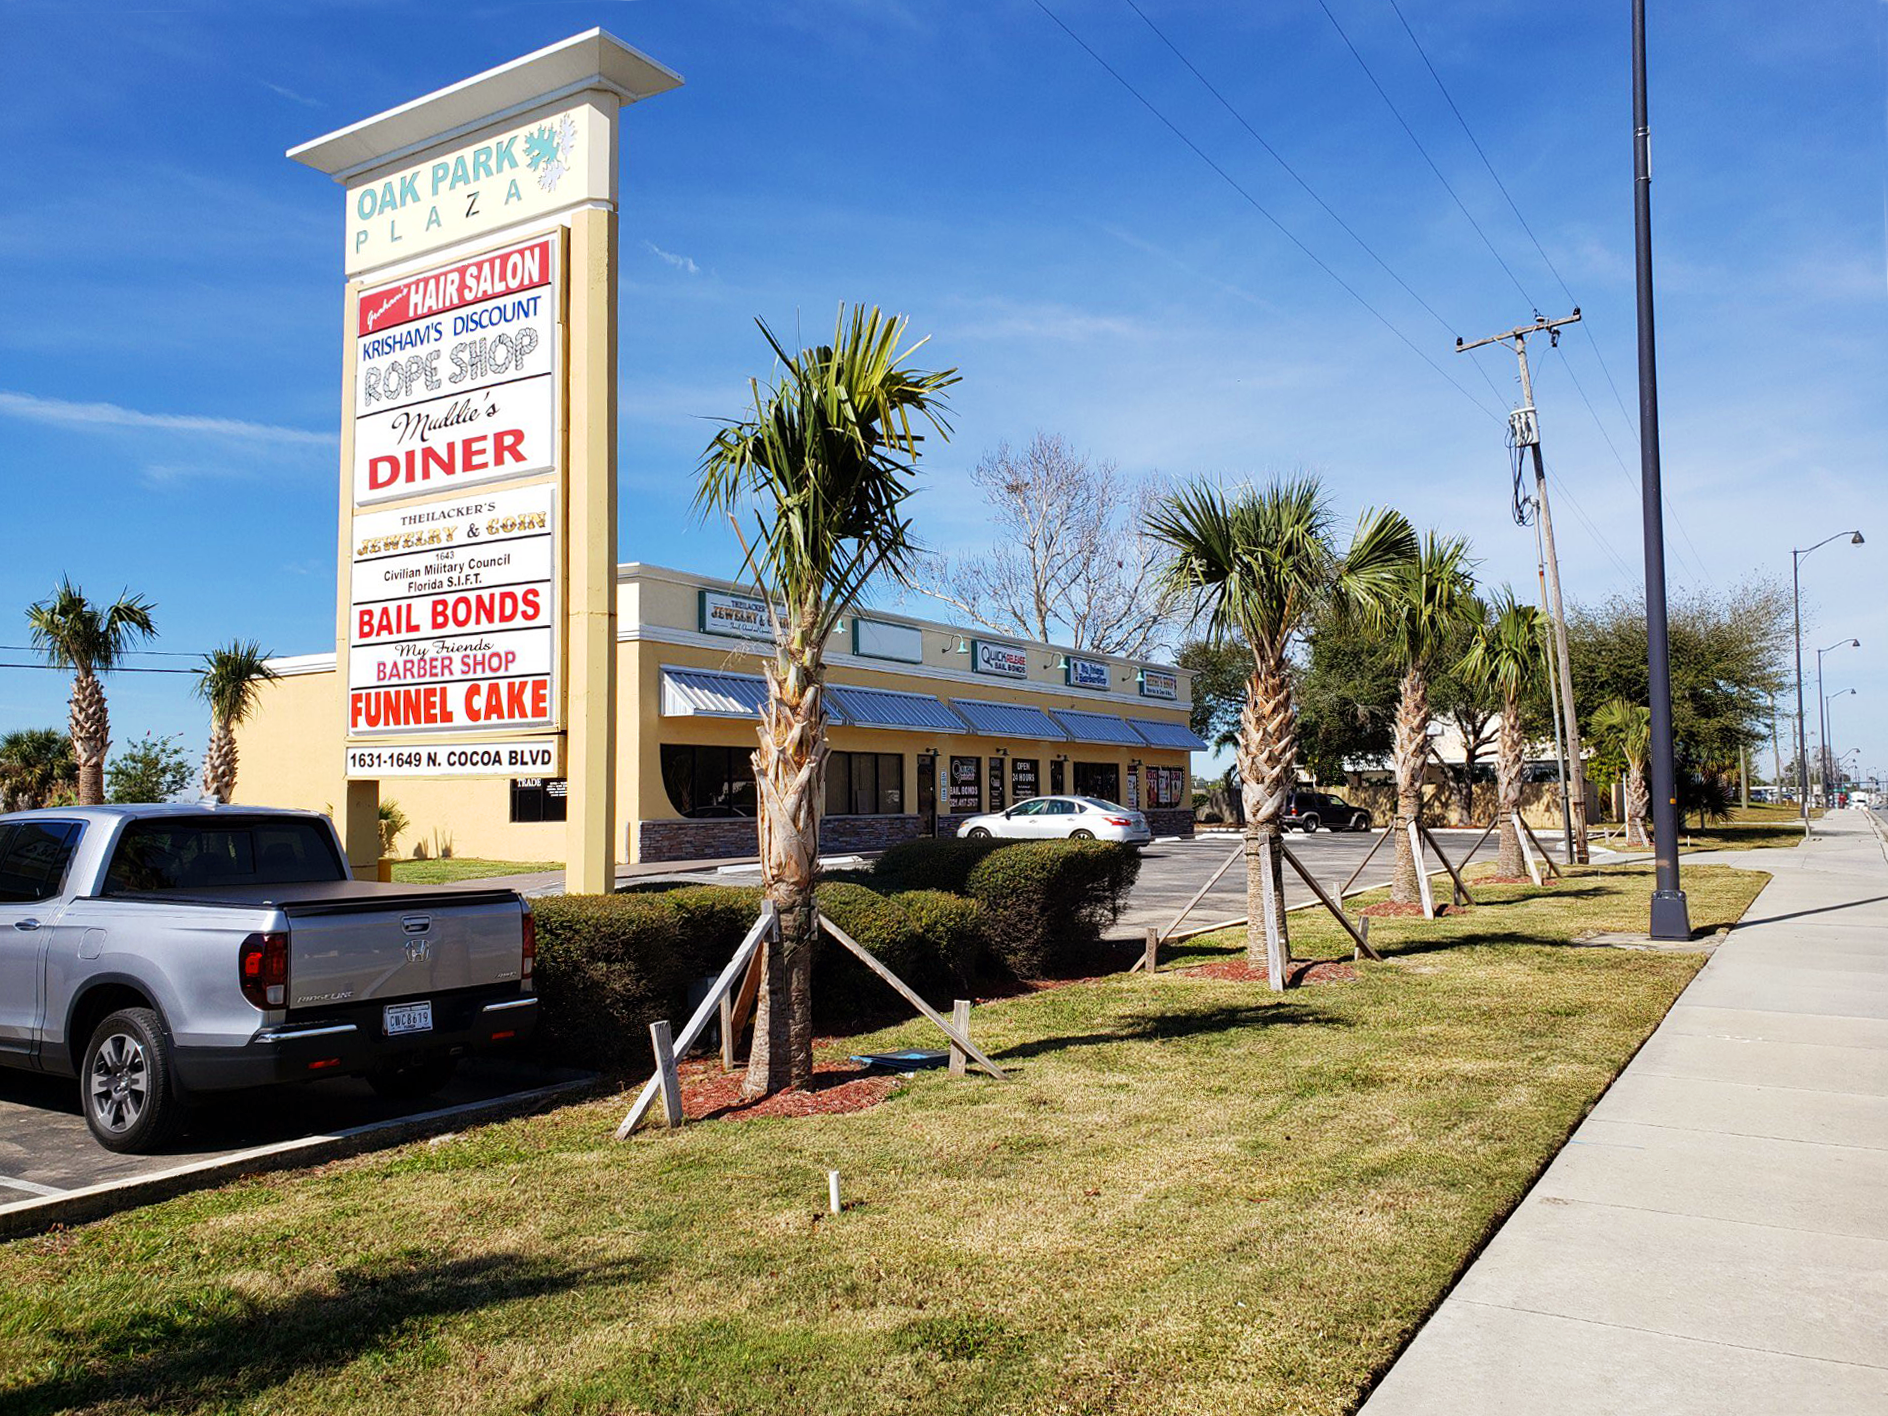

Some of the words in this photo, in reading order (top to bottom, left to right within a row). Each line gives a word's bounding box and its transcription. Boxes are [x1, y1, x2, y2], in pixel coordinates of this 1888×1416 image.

[357, 171, 421, 221] OAK
[431, 134, 520, 197] PARK
[367, 285, 409, 330] Graham's
[408, 271, 460, 318] HAIR
[463, 246, 540, 301] SALON
[362, 322, 443, 362] KRISHAM'S
[453, 295, 542, 337] DISCOUNT
[364, 349, 442, 407] ROPE
[449, 327, 539, 385] SHOP
[391, 391, 500, 445] Muddie's
[368, 428, 528, 491] DINER
[400, 501, 496, 526] THEILACKER'S
[356, 525, 458, 557] JEWELRY
[466, 522, 481, 538] &
[485, 511, 547, 536] COIN
[383, 563, 421, 582] Civilian
[424, 559, 465, 576] Military
[468, 553, 511, 570] Council
[435, 550, 455, 561] 1643
[407, 577, 444, 593] Florida
[447, 573, 482, 588] S.I.F.T.
[358, 603, 421, 640] BAIL
[431, 588, 541, 630] BONDS
[711, 606, 759, 625] JEWELRY
[394, 644, 430, 660] My
[431, 638, 495, 655] Friends
[981, 645, 1007, 668] QUICK
[375, 656, 454, 683] BARBER
[460, 651, 517, 676] SHOP
[994, 661, 1007, 671] BAIL
[1007, 664, 1026, 674] BONDS
[350, 686, 454, 729] FUNNEL
[464, 679, 548, 723] CAKE
[349, 752, 422, 768] 1631-1649
[426, 752, 442, 767] N.
[446, 751, 503, 767] COCOA
[508, 749, 552, 766] BLVD
[1017, 762, 1030, 771] OPEN
[517, 778, 542, 788] TRADE
[1012, 773, 1018, 782] 24
[1019, 773, 1035, 782] HOURS
